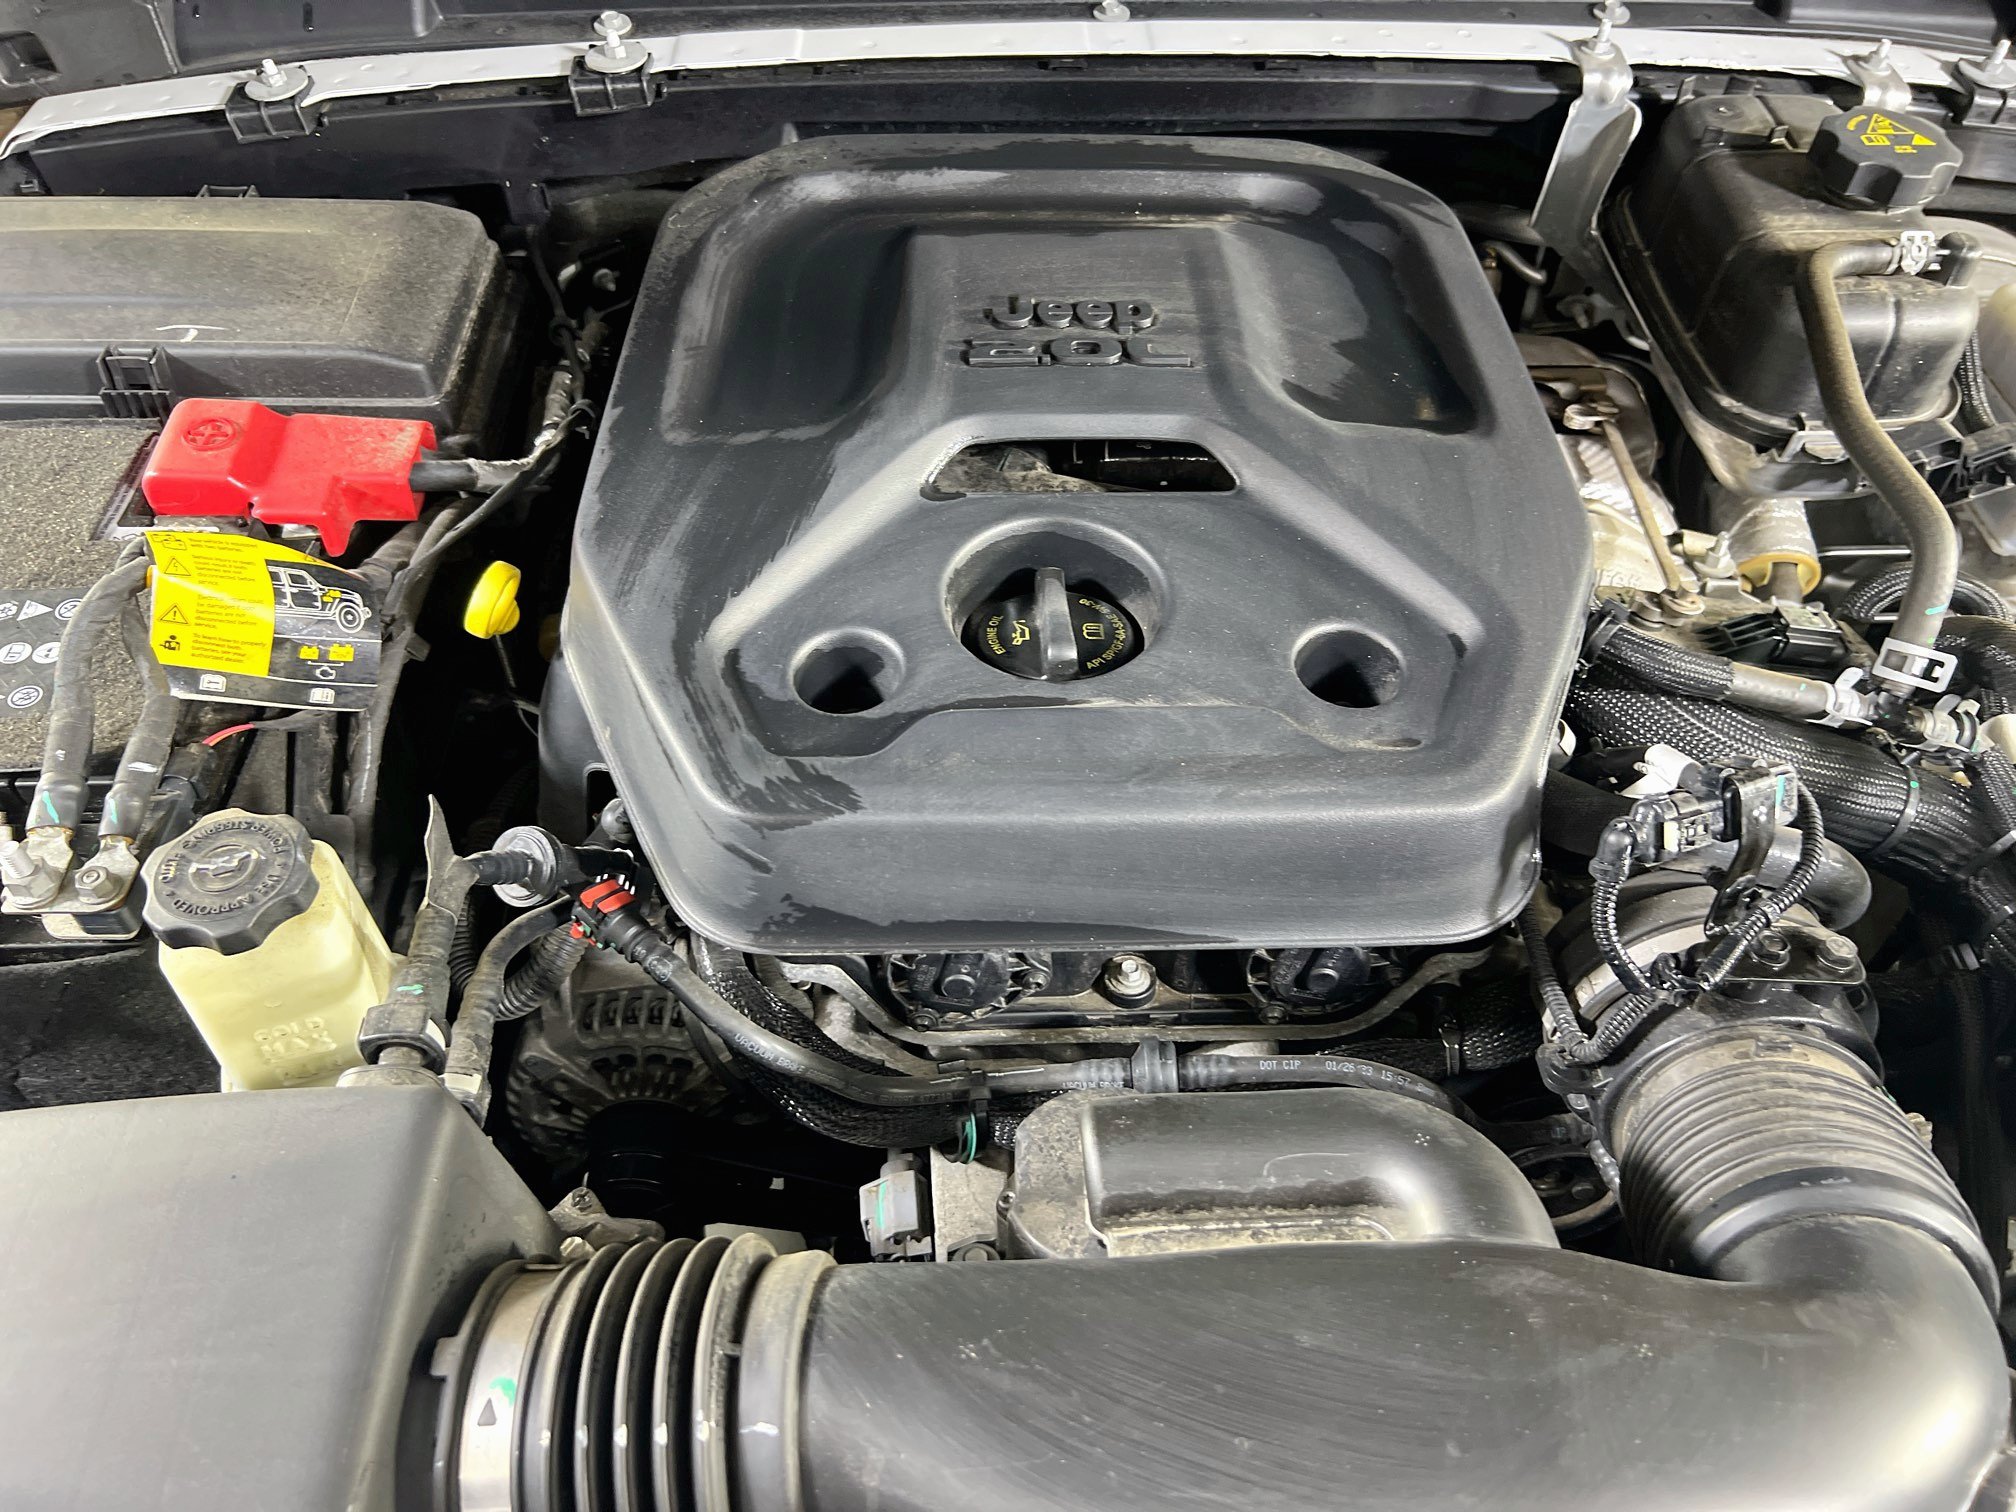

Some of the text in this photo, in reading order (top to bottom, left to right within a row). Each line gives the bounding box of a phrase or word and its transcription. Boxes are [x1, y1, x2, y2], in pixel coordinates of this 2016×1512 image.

[983, 295, 1157, 335] Jeep
[960, 336, 1191, 367] 2.0L
[986, 615, 1006, 655] ENGINE OIL
[1086, 657, 1106, 669] API
[251, 820, 288, 854] POWER
[173, 874, 281, 916] USE APPROVED
[735, 1033, 775, 1061] VACUUM
[1259, 1060, 1278, 1070] DOT
